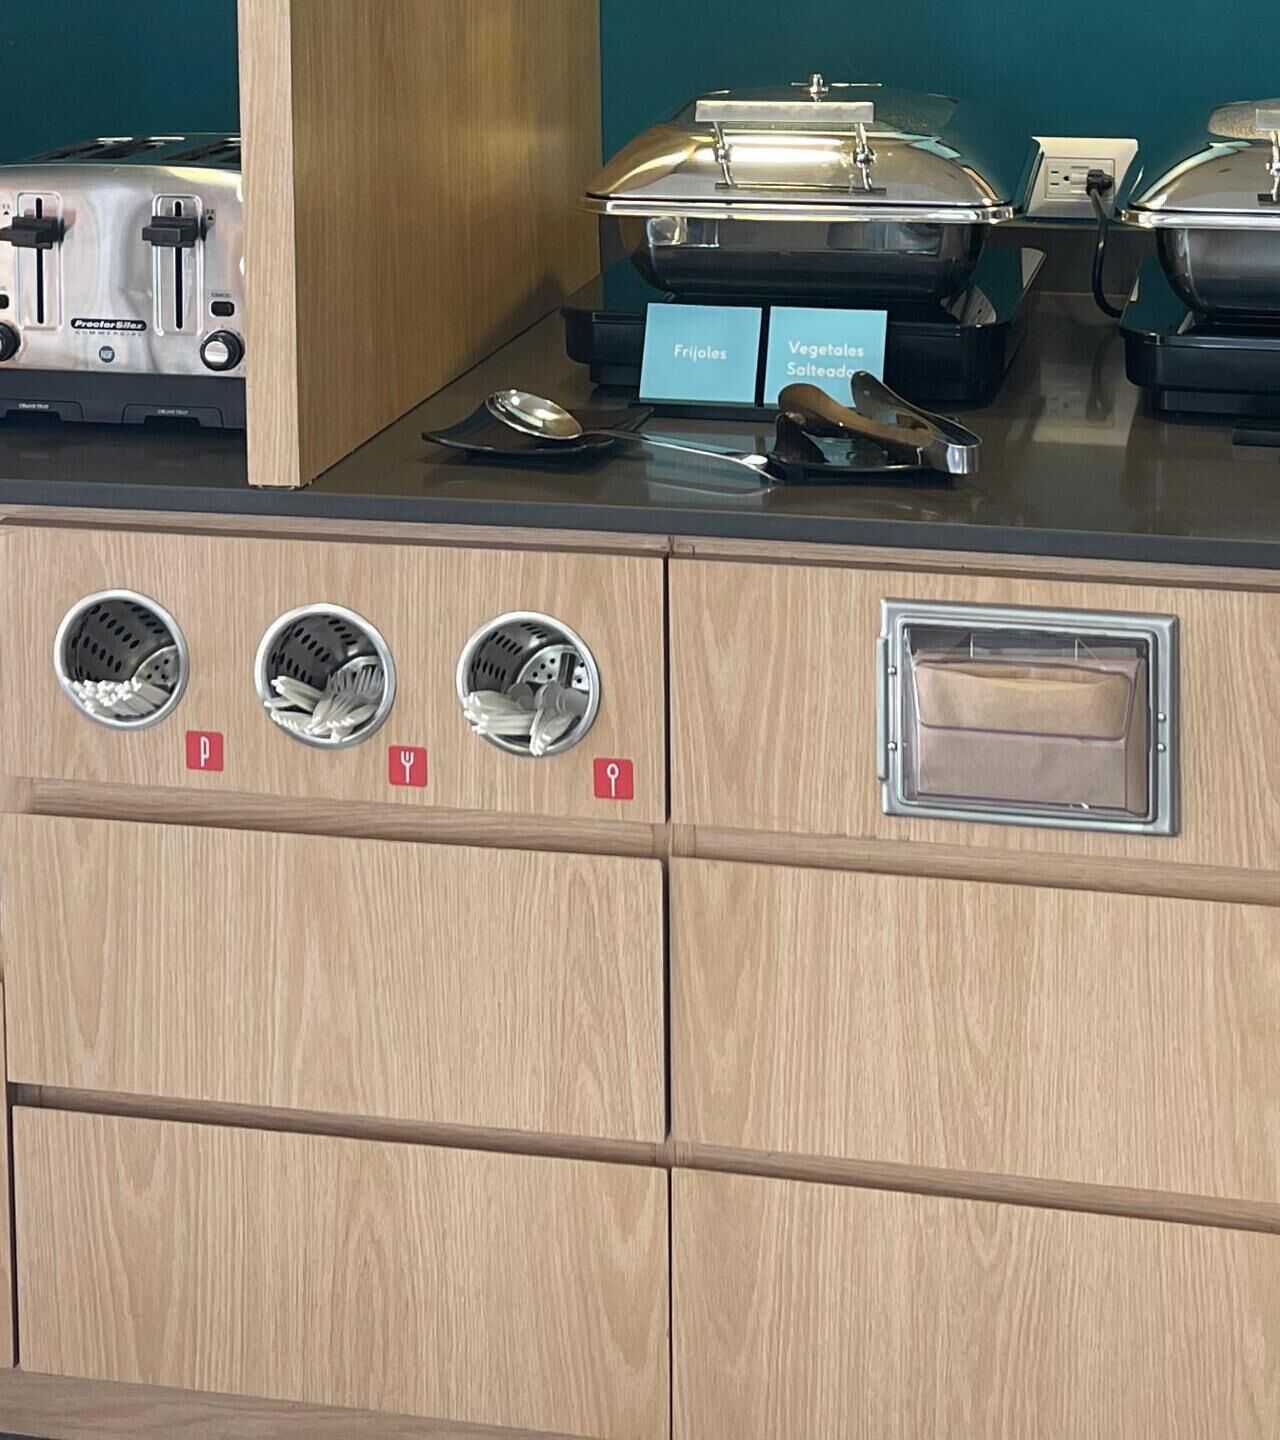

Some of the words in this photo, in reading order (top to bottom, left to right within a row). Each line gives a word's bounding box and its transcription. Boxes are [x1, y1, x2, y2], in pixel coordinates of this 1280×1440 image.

[673, 343, 727, 363] Frijoles
[788, 340, 865, 359] Vegetales
[786, 361, 859, 379] Salteado
